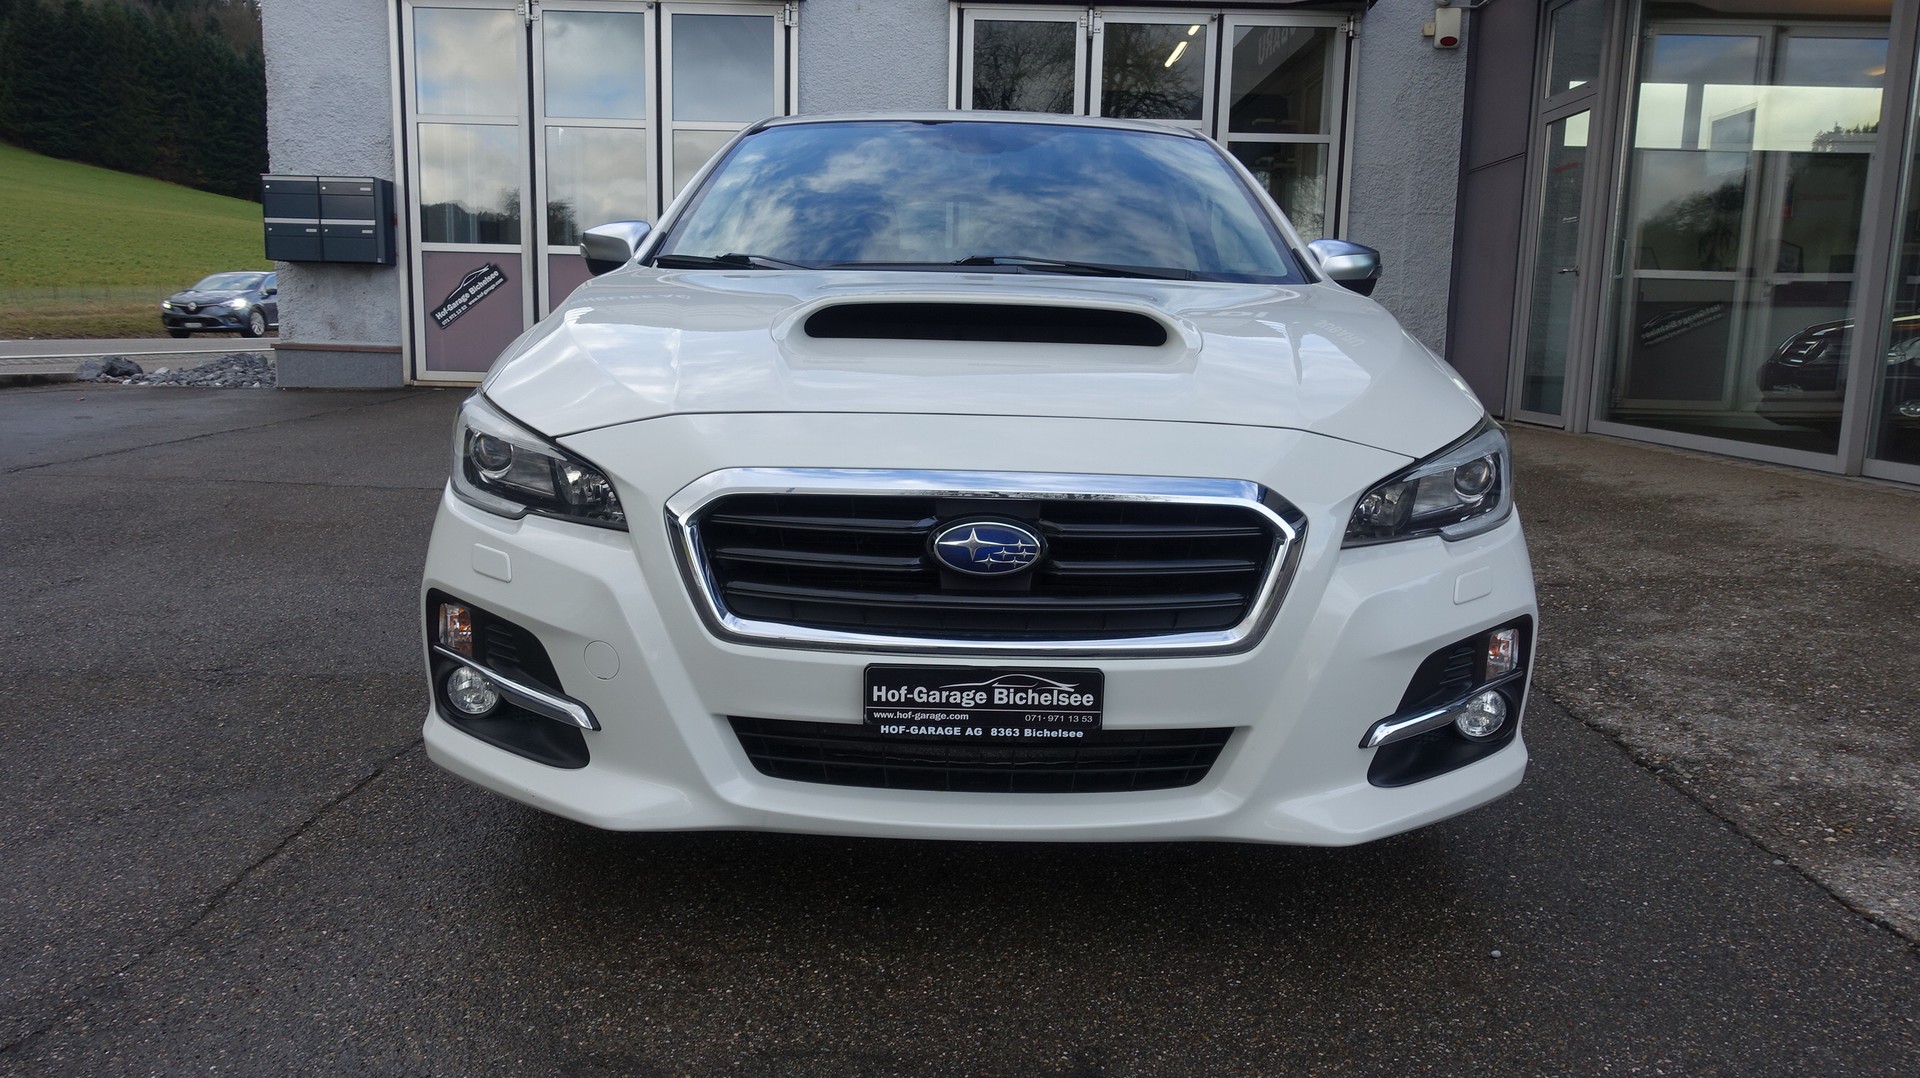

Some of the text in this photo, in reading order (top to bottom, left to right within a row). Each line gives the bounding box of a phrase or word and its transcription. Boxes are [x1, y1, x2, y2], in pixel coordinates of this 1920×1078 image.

[435, 270, 499, 320] Hof-Garage Bichelsee
[872, 686, 1094, 707] Hof-Garage Bichelsee
[873, 711, 969, 721] www.hof-garage.com
[1068, 715, 1079, 723] 13
[1081, 715, 1093, 723] 53
[880, 725, 1084, 738] HOF-GARAGE AG 8363 Bichelsee
